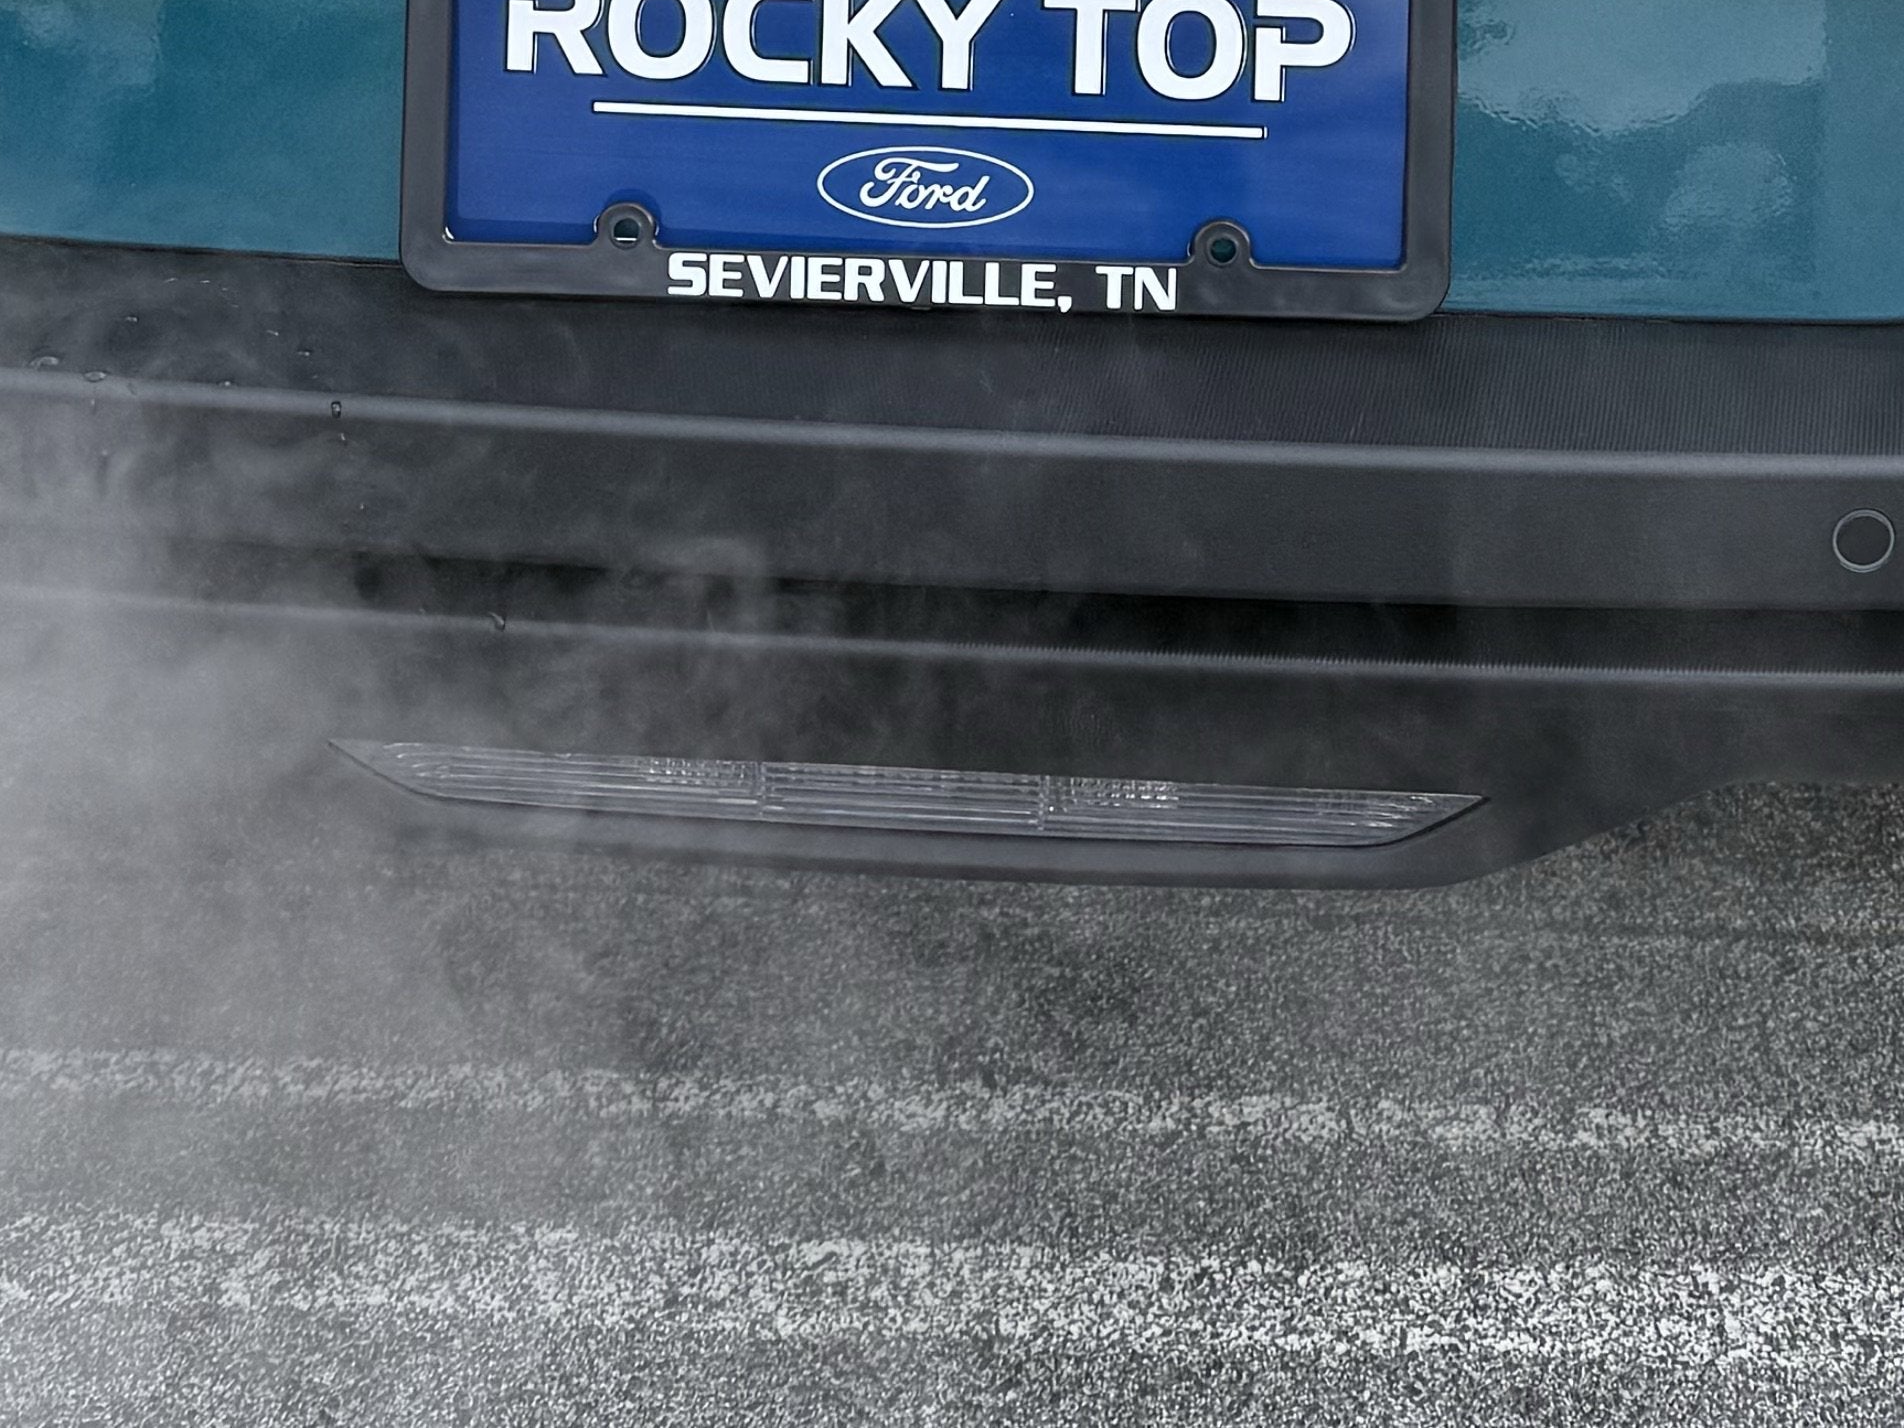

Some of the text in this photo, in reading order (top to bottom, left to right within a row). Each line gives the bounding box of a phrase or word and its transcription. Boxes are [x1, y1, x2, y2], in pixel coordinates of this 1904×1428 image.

[859, 156, 990, 213] Ford
[667, 252, 1178, 314] SEVIERVILLE, TN
